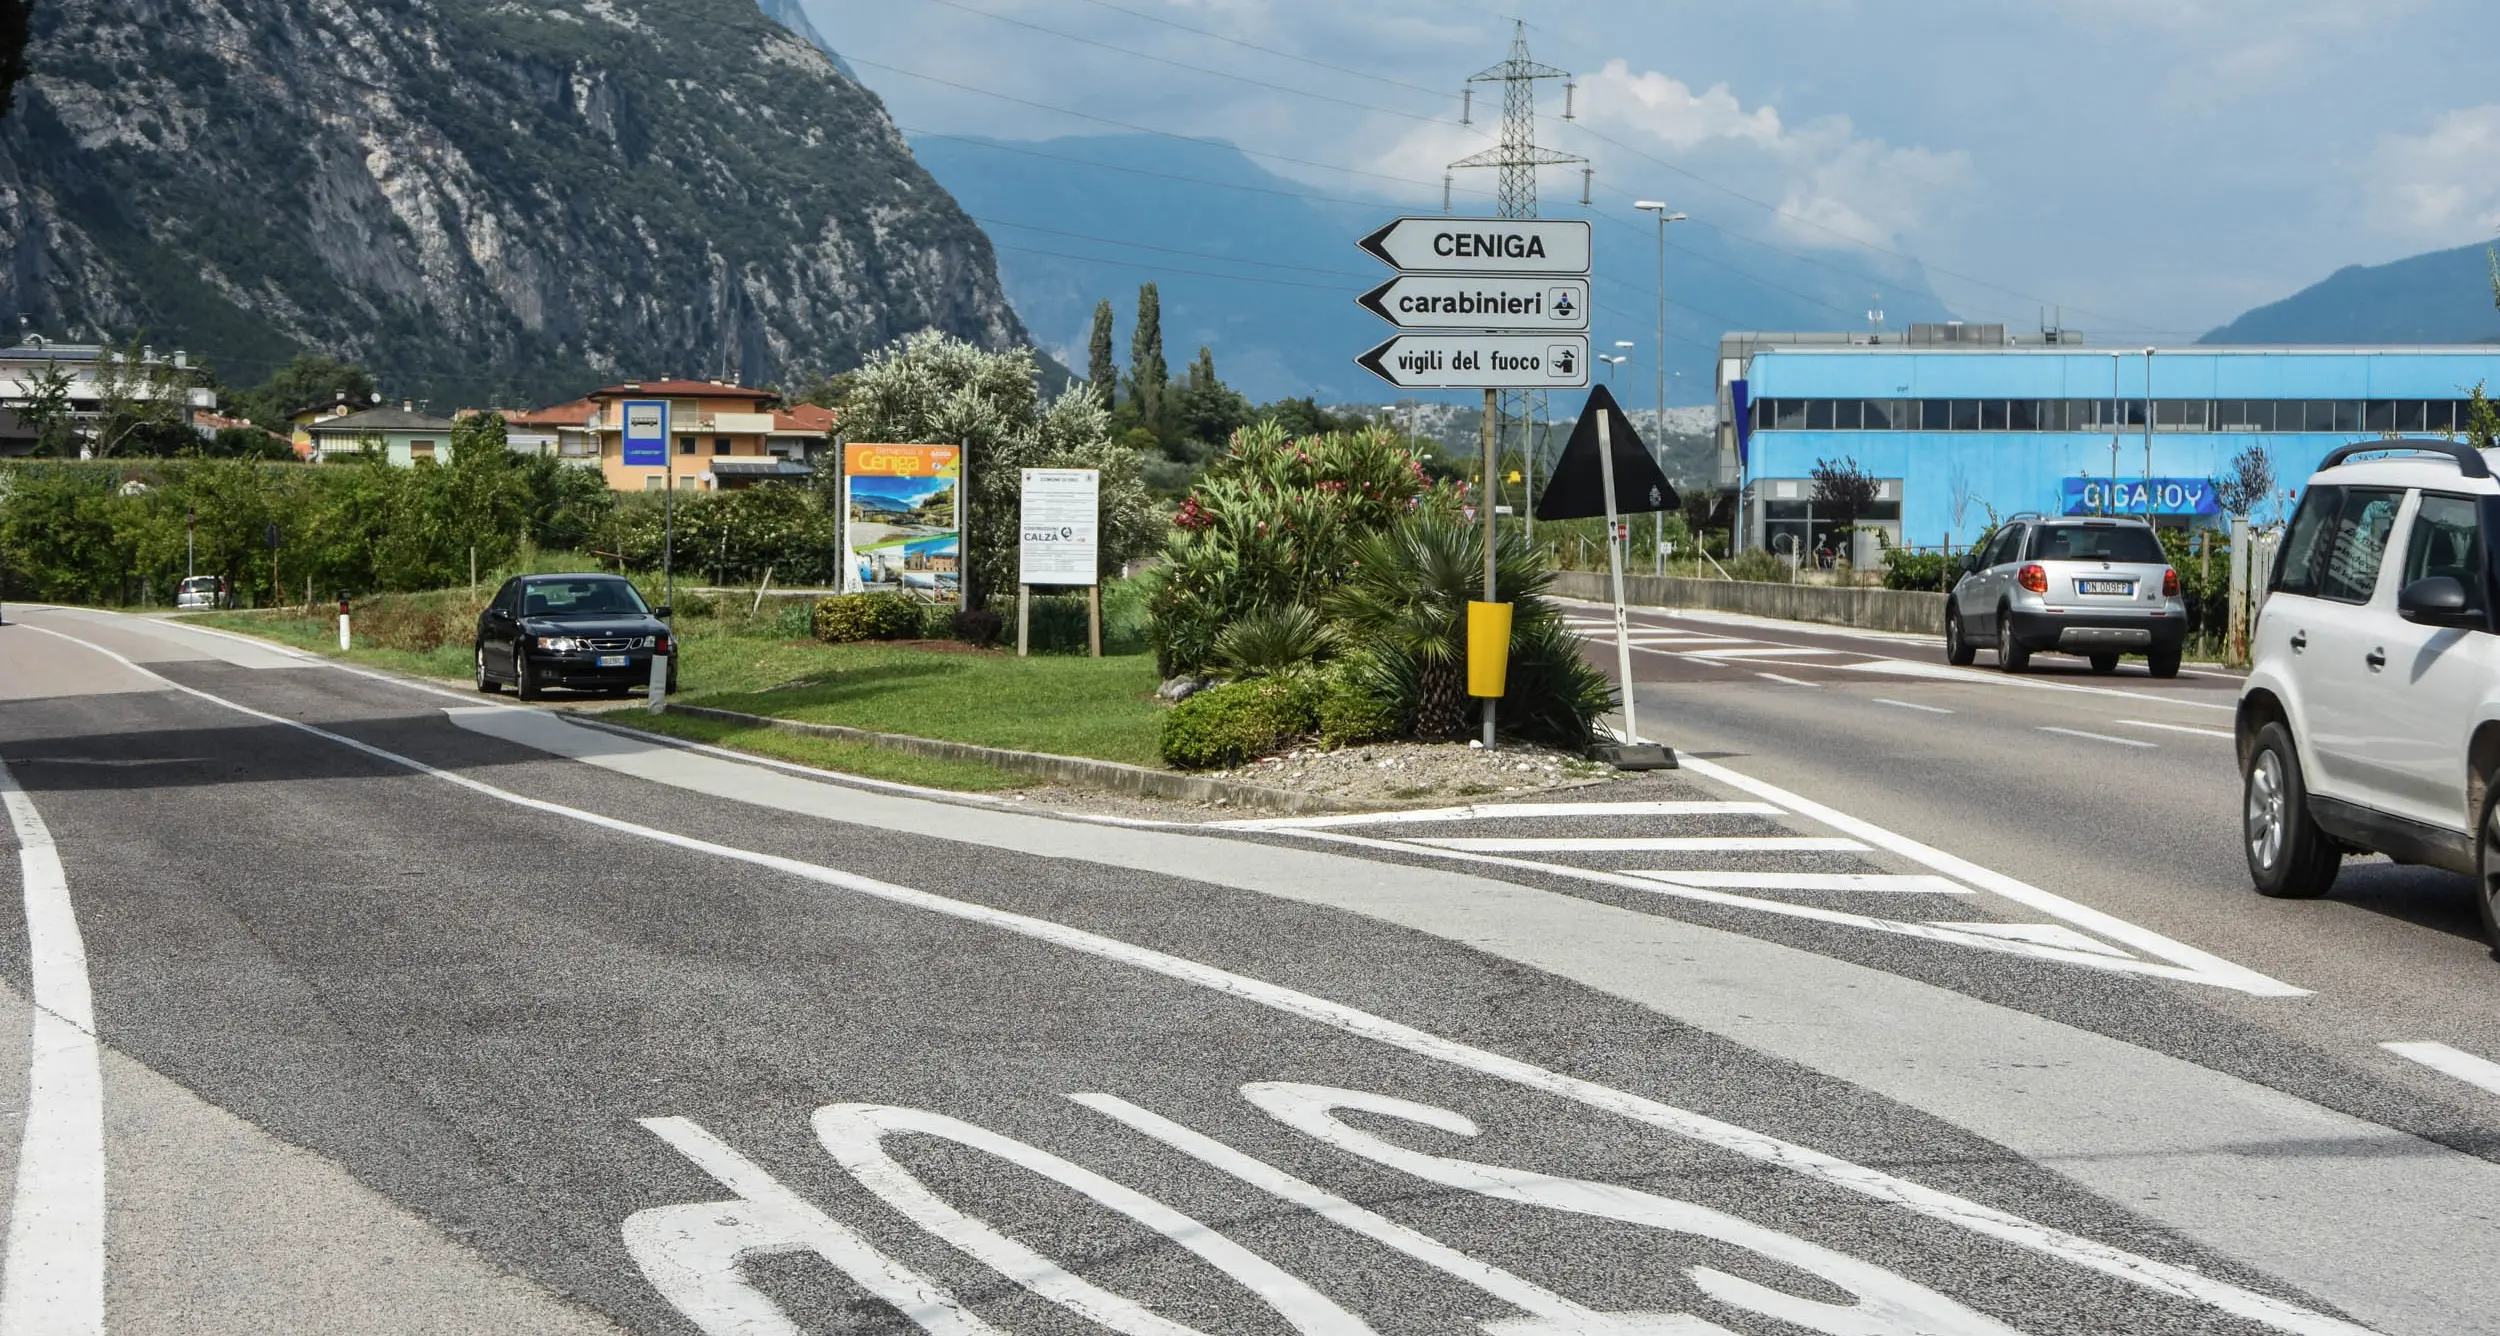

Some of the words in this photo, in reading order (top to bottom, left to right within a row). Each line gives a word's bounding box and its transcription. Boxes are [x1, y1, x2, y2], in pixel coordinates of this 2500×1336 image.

[1433, 232, 1546, 258] CENIGA
[1399, 291, 1541, 315] carabinieri
[1398, 350, 1443, 374] vigili
[1452, 350, 1480, 370] del
[1491, 351, 1540, 371] fuoco
[858, 450, 920, 476] Ceniga
[2084, 483, 2202, 508] GIGAJOY
[2086, 582, 2097, 592] DN
